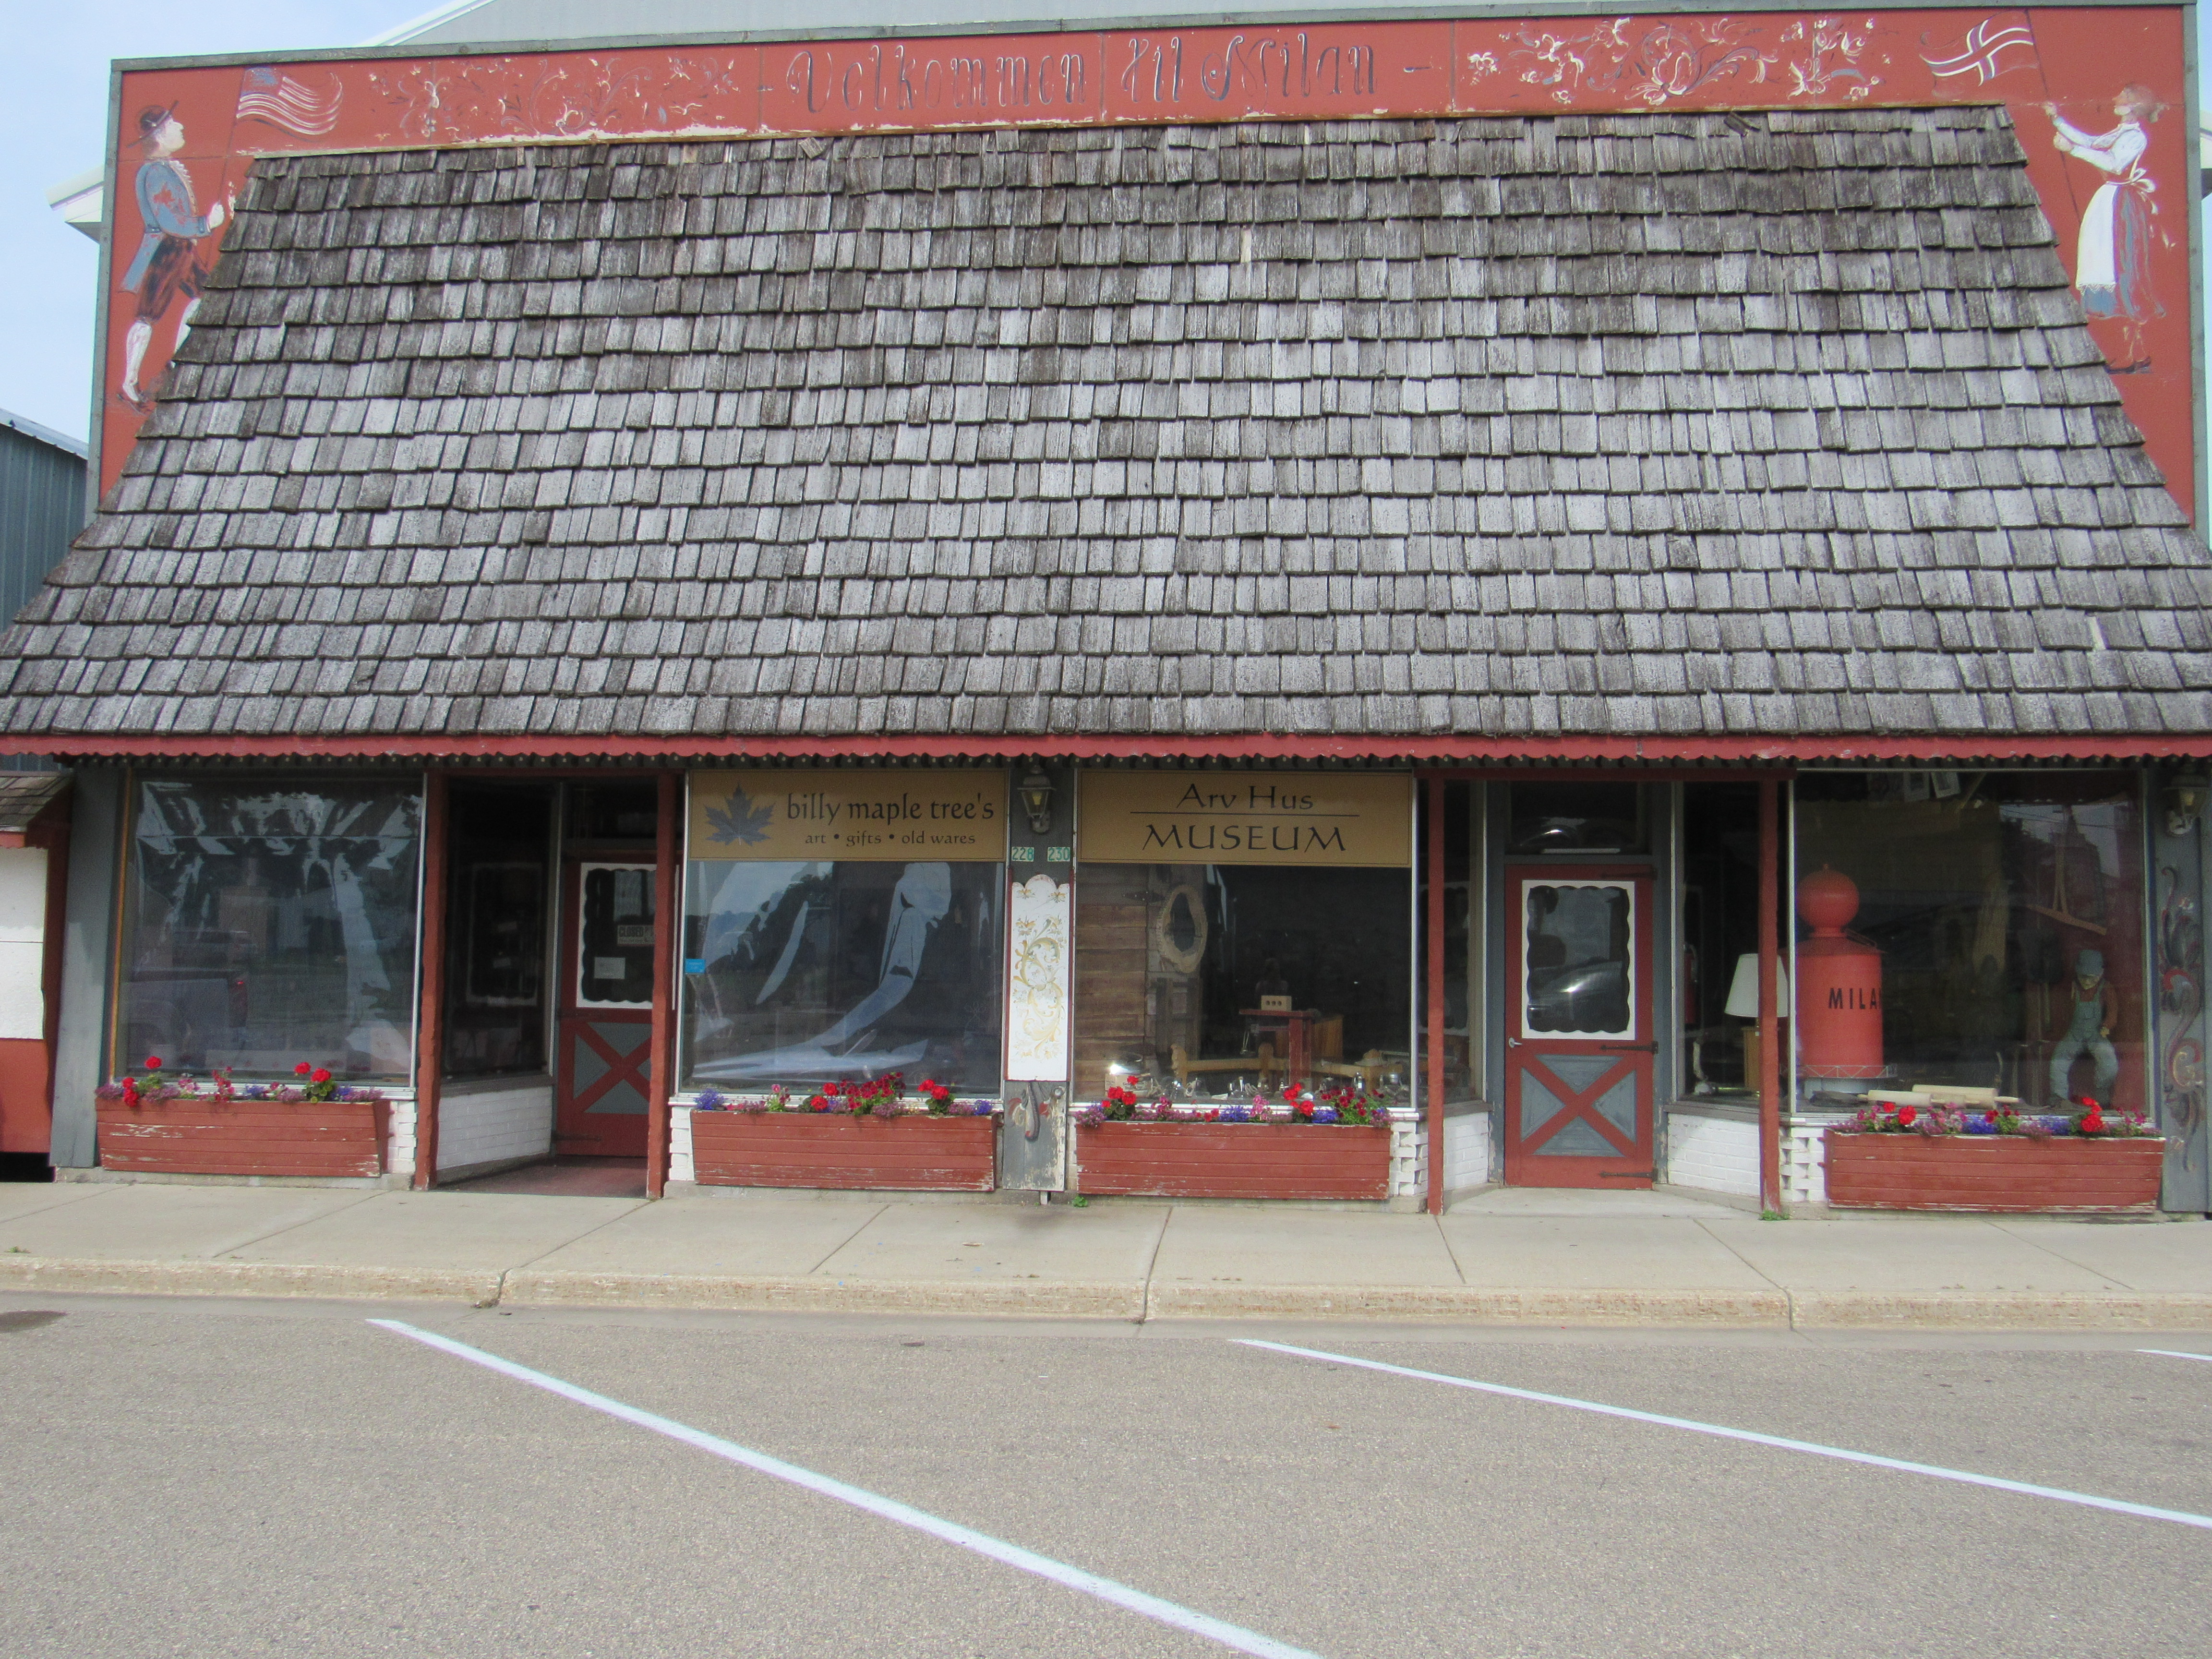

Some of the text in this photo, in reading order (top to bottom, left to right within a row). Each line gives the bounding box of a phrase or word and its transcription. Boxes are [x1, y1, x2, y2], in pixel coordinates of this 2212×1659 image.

[1176, 783, 1313, 810] Arv Hus
[787, 793, 994, 826] billy maple tree's
[805, 830, 976, 847] art gifts old wares
[1142, 824, 1346, 852] MUSEUM
[1012, 847, 1034, 861] 228
[1048, 847, 1070, 861] 230
